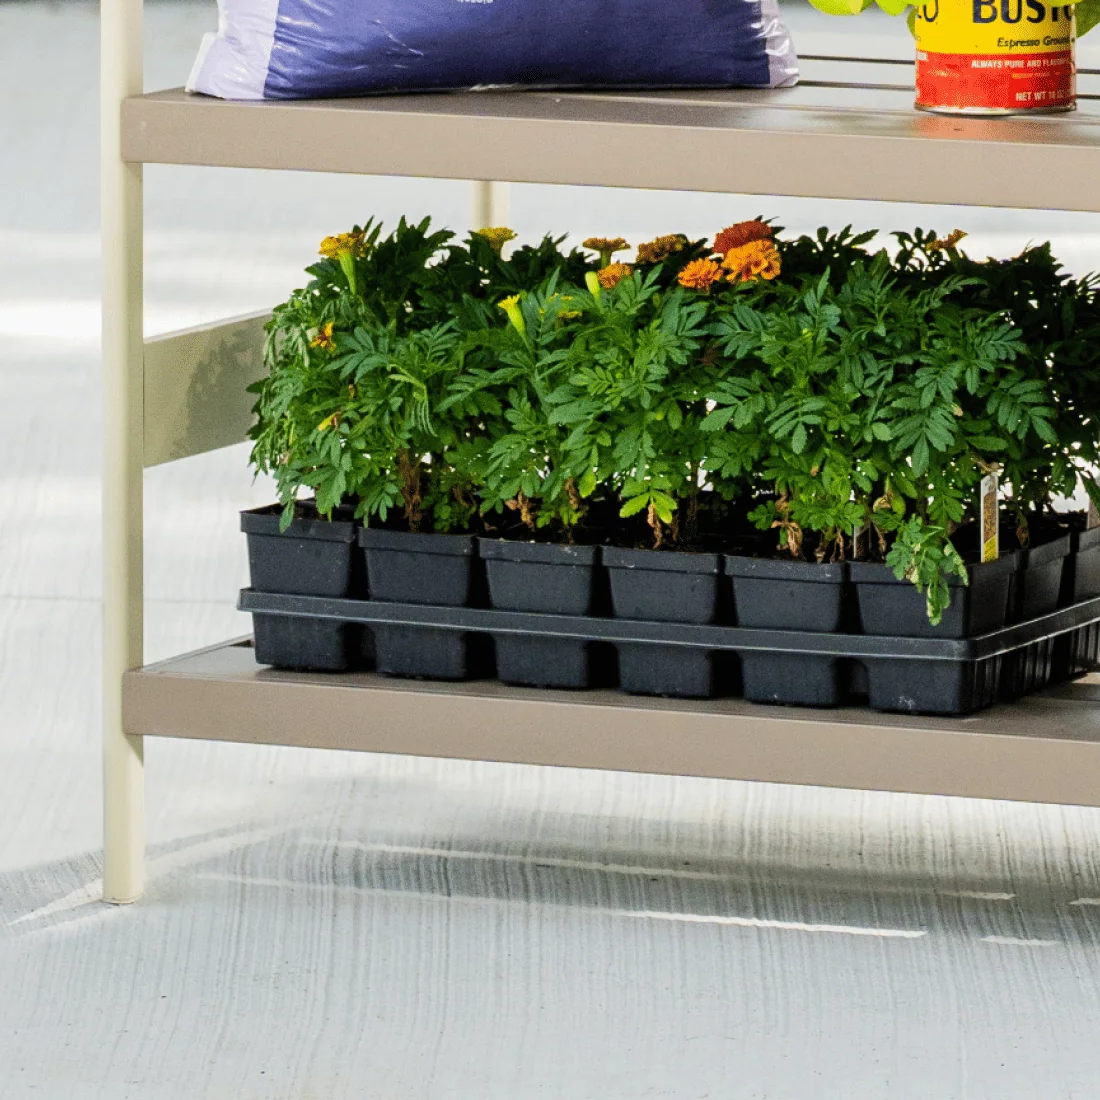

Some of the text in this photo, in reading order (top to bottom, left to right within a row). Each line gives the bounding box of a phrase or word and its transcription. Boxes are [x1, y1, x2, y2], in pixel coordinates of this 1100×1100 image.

[996, 36, 1041, 51] Espresso
[970, 59, 1003, 69] ALWAYS
[1004, 59, 1025, 69] PURE
[1026, 59, 1042, 69] AND
[1015, 91, 1032, 102] NET
[1033, 90, 1047, 101] WT
